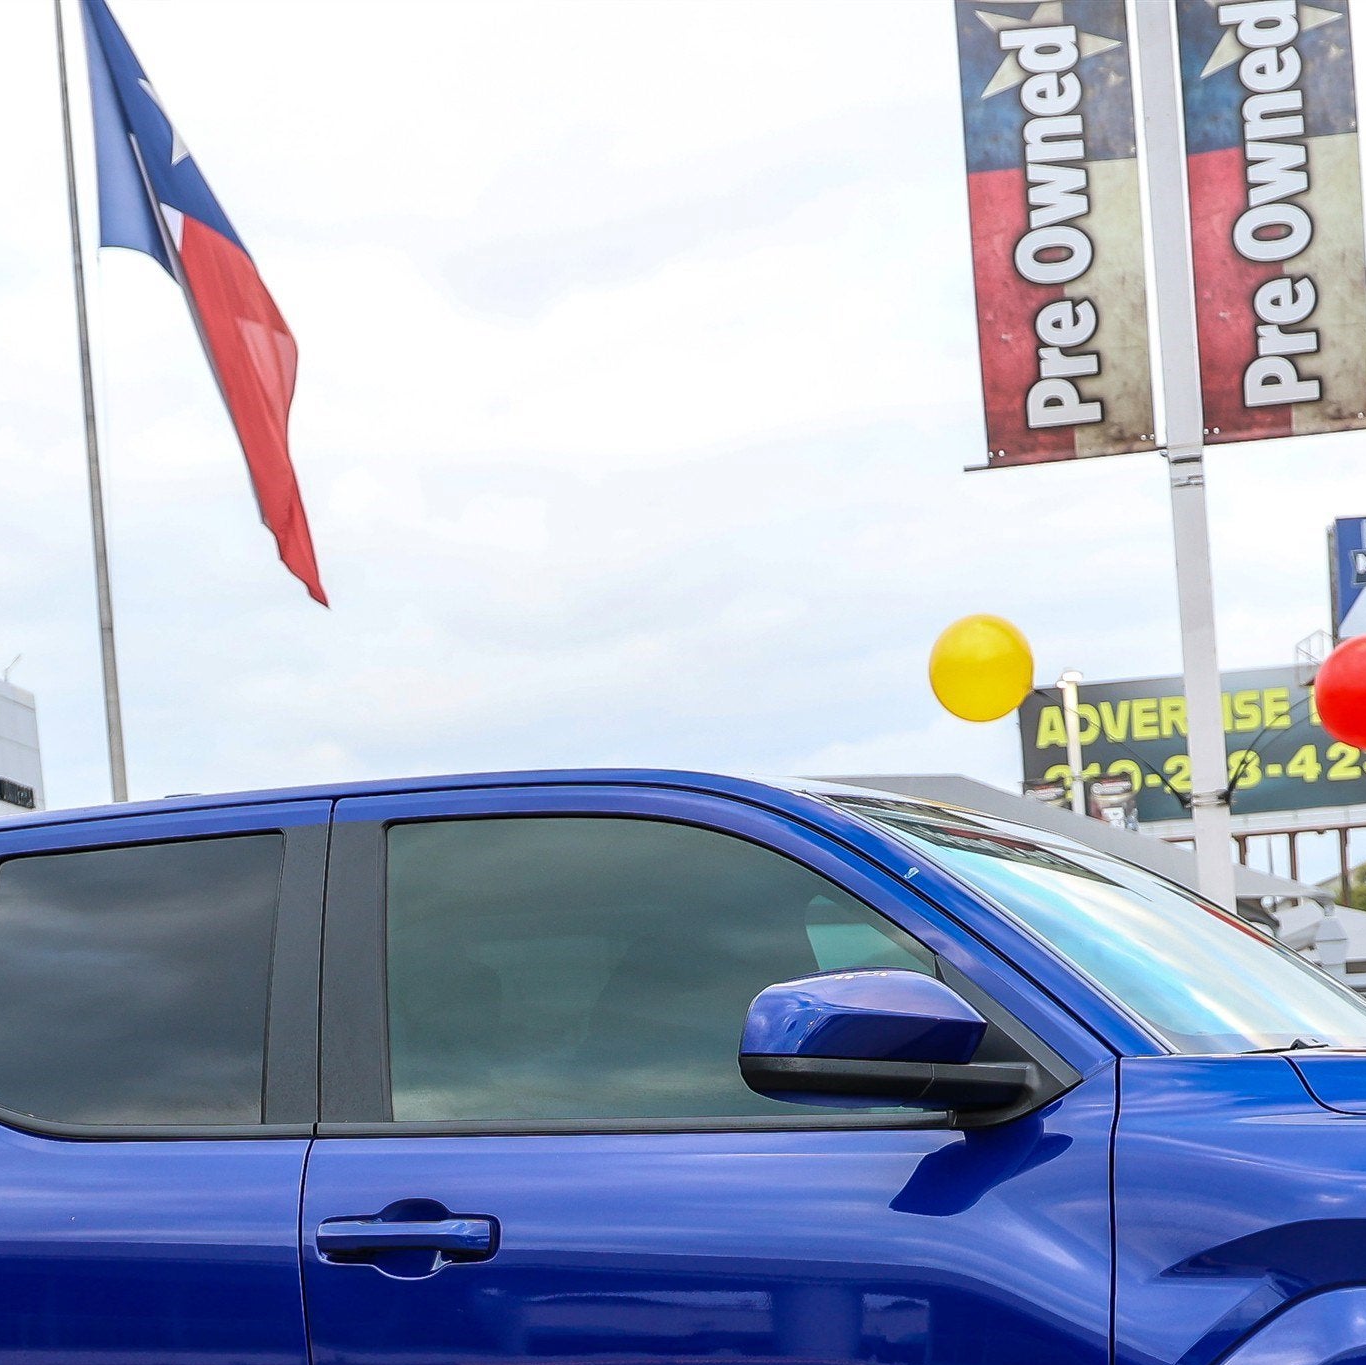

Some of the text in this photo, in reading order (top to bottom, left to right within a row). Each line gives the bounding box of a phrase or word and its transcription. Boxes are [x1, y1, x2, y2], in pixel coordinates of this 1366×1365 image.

[998, 24, 1105, 430] Pre Owned
[1217, 0, 1321, 408] Pre Owned
[1036, 686, 1292, 749] ADVERISE
